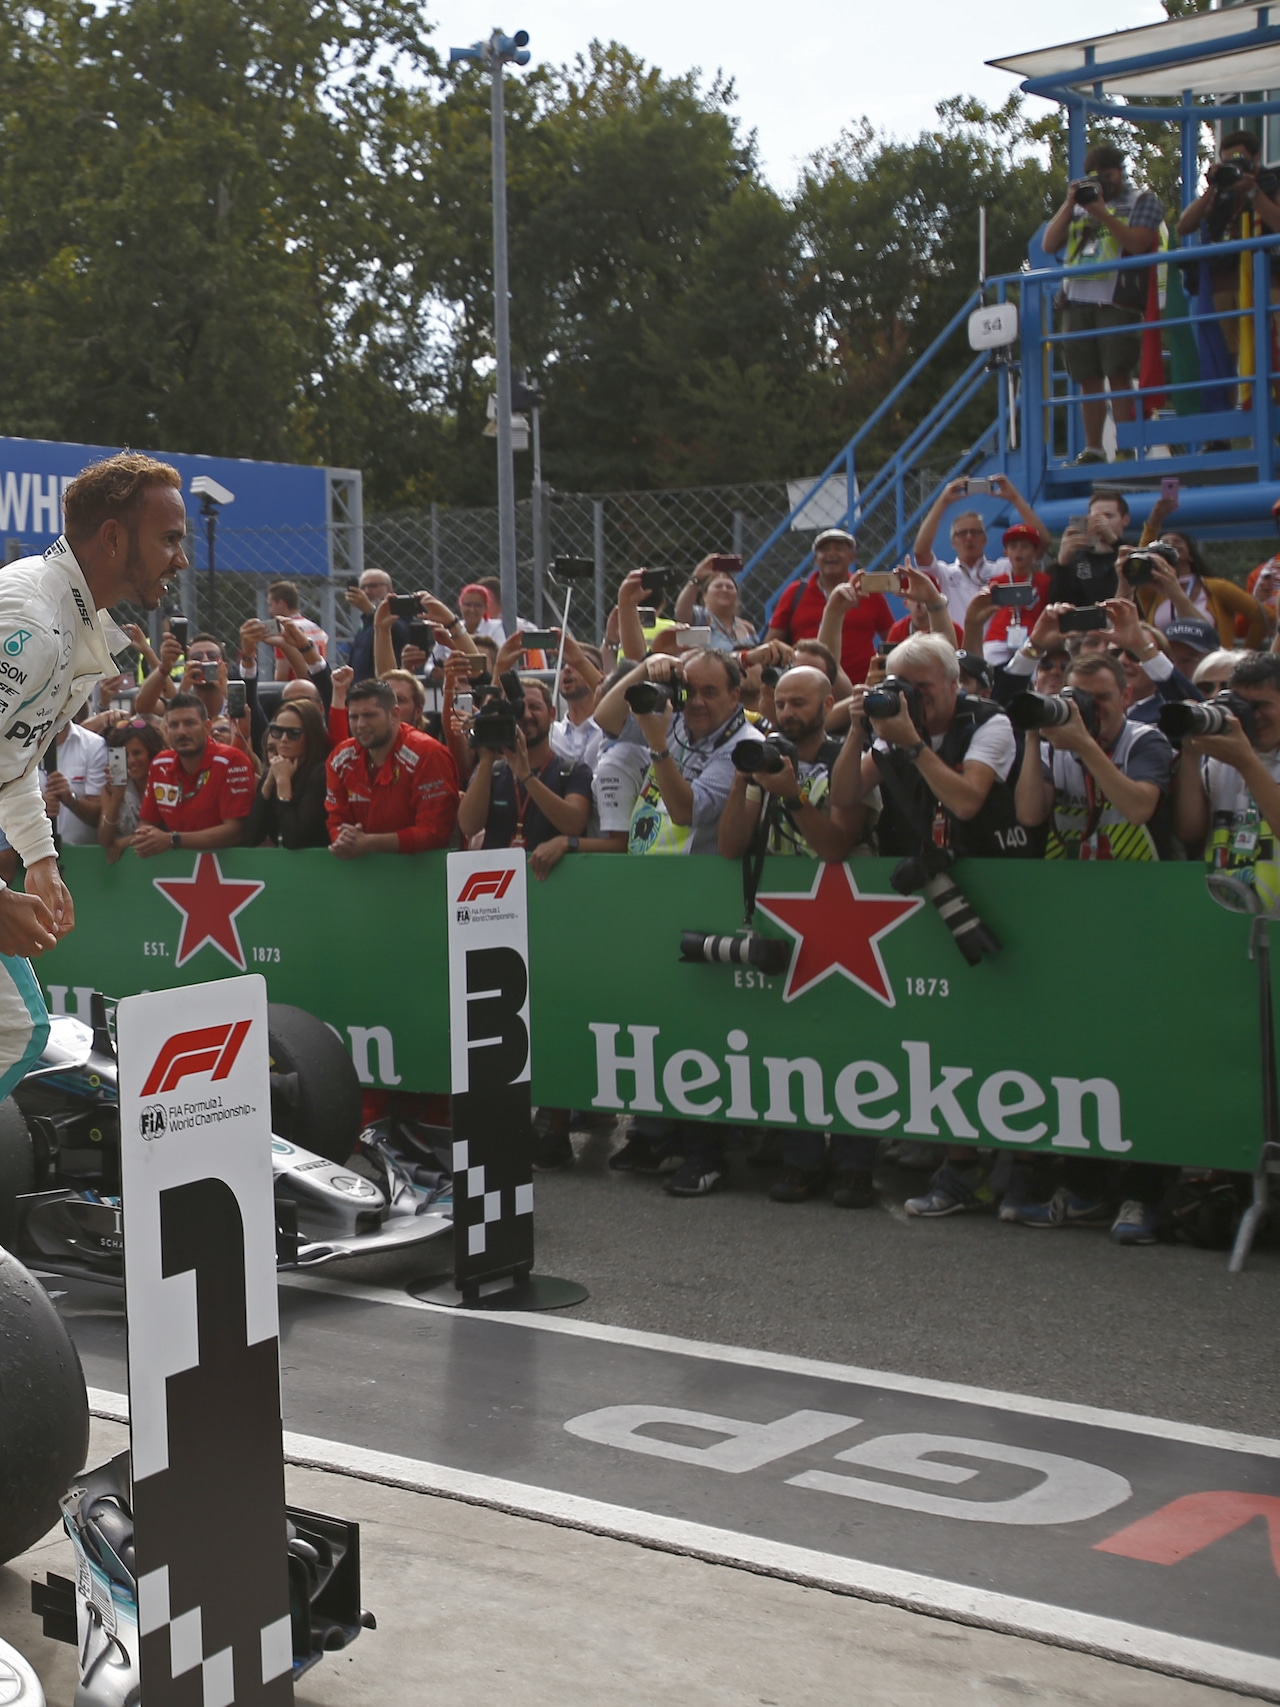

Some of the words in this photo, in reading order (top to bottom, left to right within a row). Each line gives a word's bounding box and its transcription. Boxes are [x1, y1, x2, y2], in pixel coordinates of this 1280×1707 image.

[994, 825, 1028, 851] 140
[143, 941, 169, 957] EST.
[252, 946, 281, 963] 1873
[734, 970, 773, 989] EST.
[905, 976, 950, 998] 1873
[465, 946, 529, 1086] 3
[139, 1019, 253, 1097] F1
[588, 1021, 1133, 1153] Heineken
[169, 1105, 183, 1118] FIA
[184, 1098, 218, 1114] Formula
[218, 1096, 223, 1107] 1
[169, 1117, 194, 1132] World
